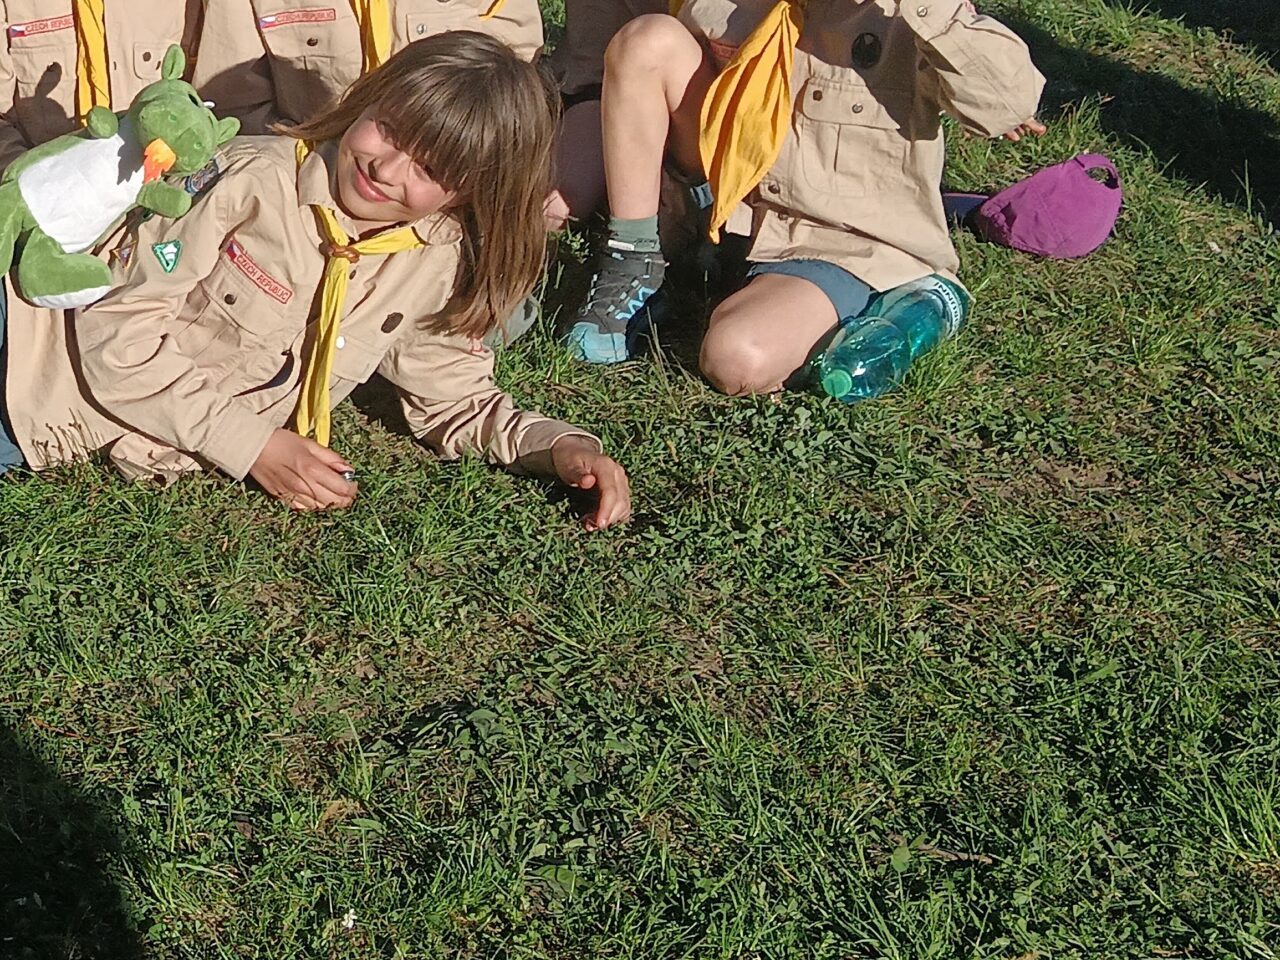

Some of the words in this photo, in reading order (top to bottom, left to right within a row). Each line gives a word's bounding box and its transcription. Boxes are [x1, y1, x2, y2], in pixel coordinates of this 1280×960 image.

[25, 22, 49, 32] CZECH
[237, 255, 258, 278] CZECH
[257, 275, 289, 300] REPUBLIC
